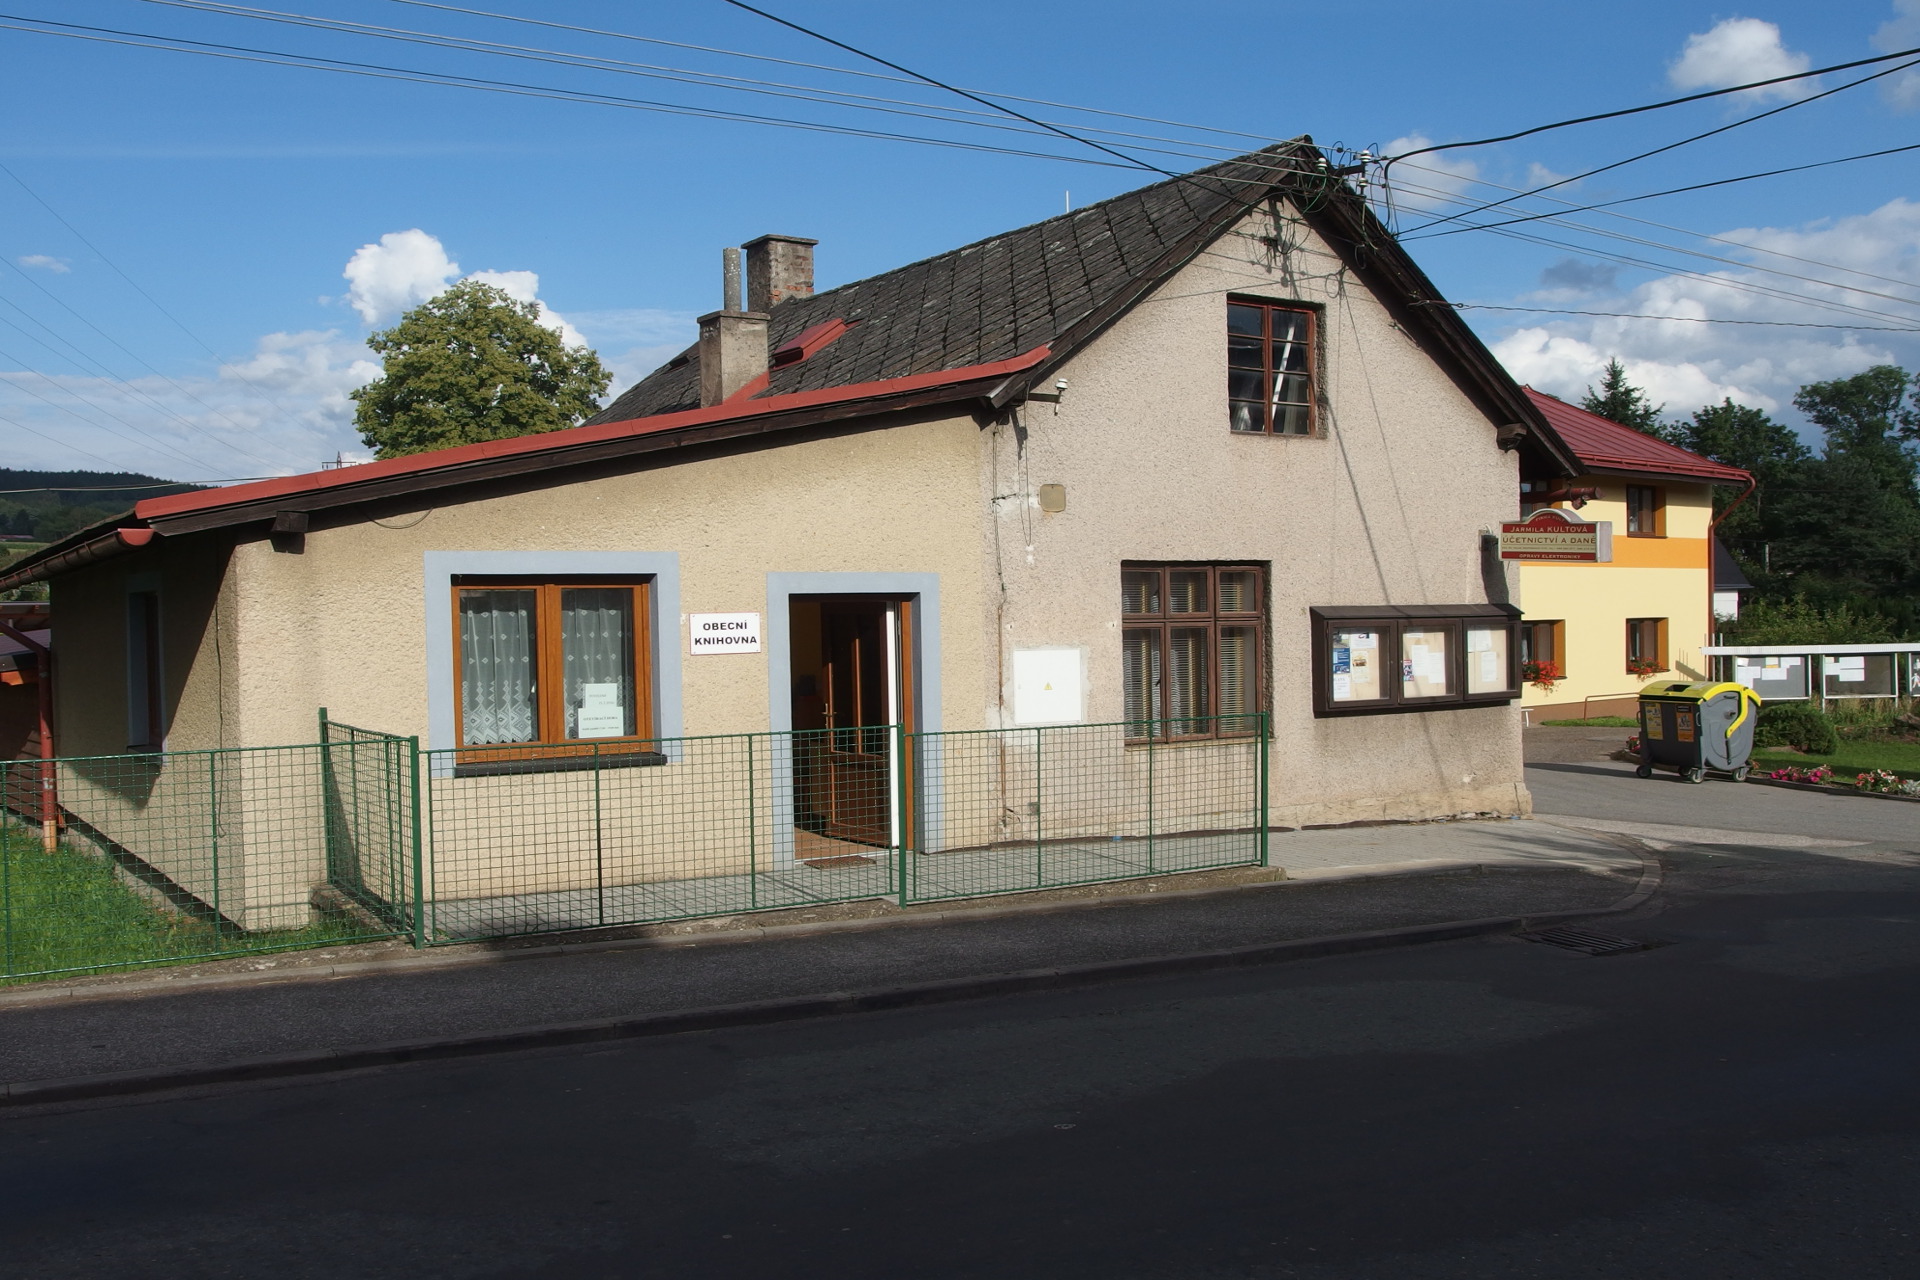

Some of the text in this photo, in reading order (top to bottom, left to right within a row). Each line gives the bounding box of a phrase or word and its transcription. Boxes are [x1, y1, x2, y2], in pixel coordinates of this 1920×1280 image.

[1547, 525, 1588, 533] KULTOVÁ
[1502, 535, 1558, 544] ÚČETNICTVÍ
[1570, 535, 1596, 544] DANĚ
[702, 619, 747, 631] OBECNÍ
[694, 636, 757, 646] KNIHOVNA
